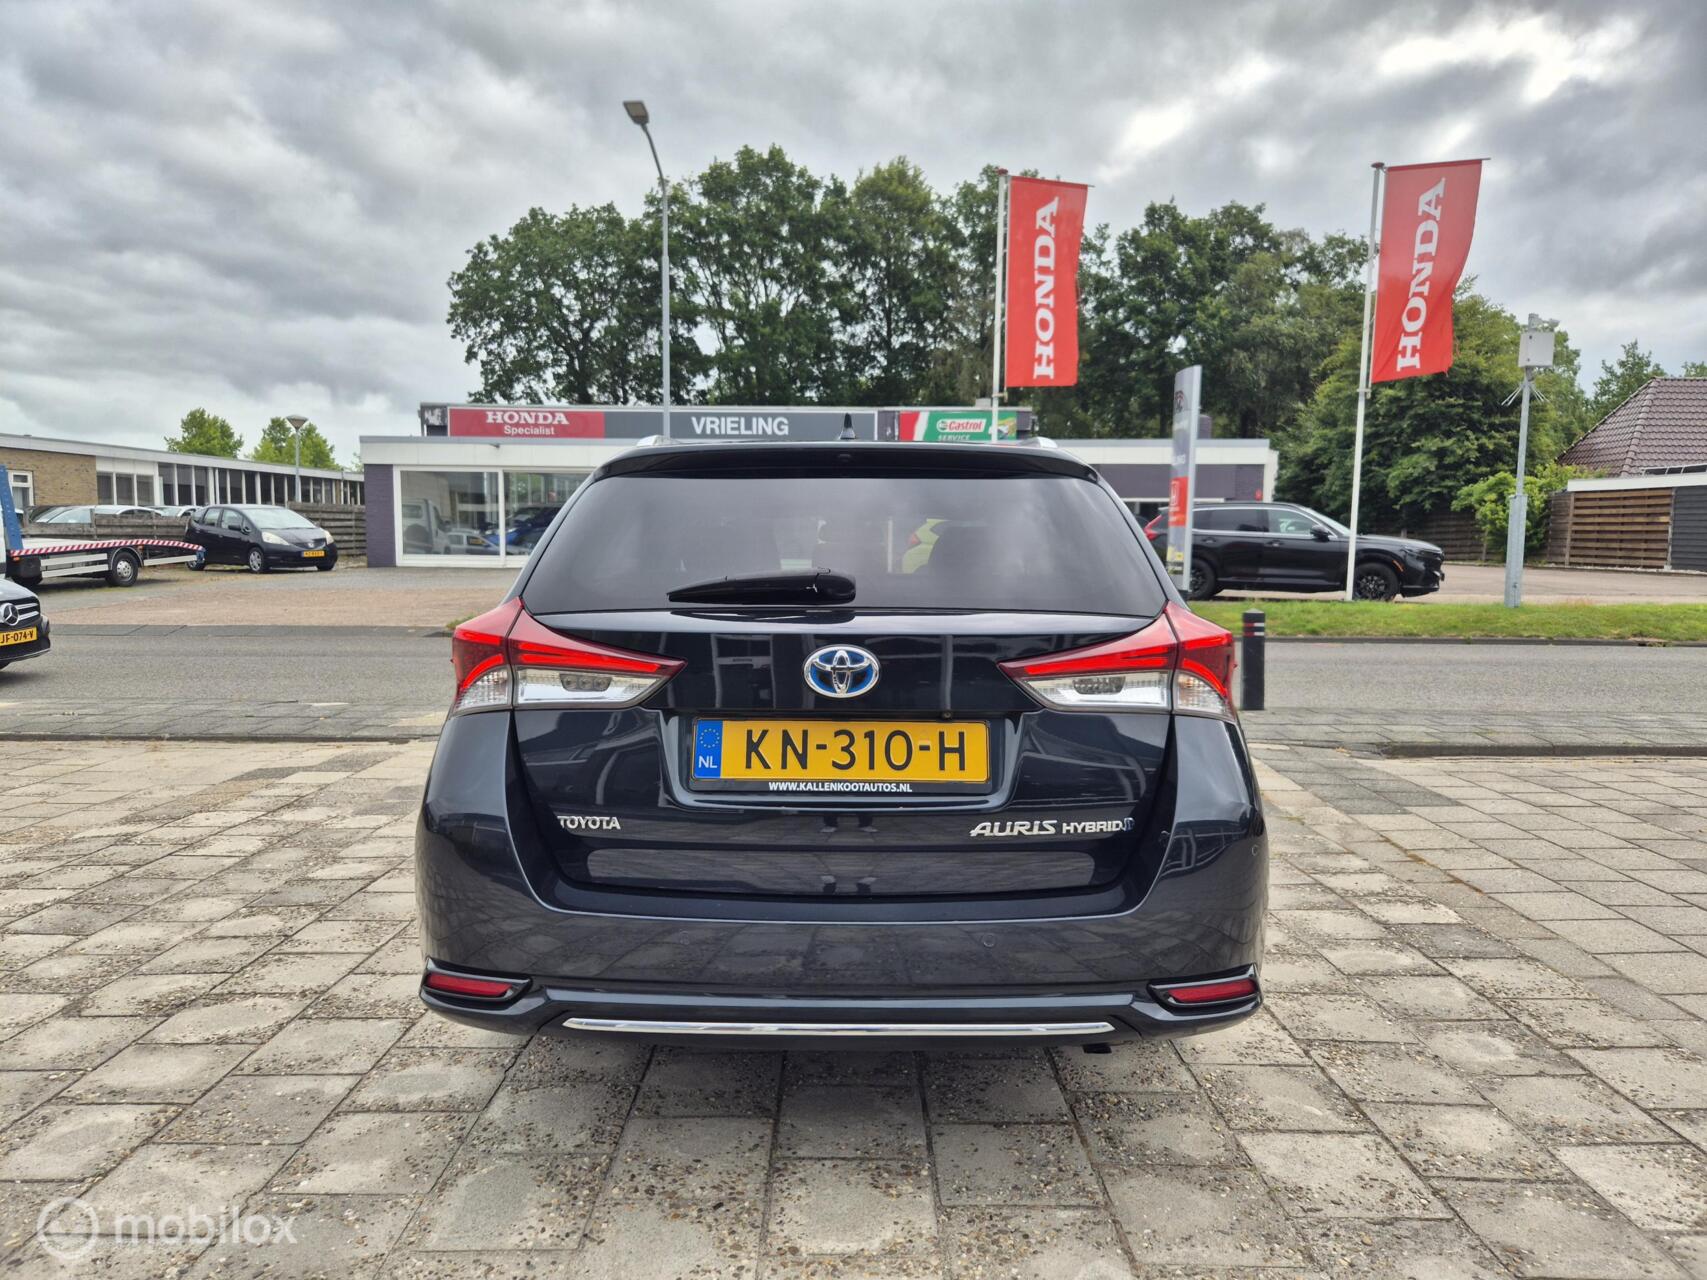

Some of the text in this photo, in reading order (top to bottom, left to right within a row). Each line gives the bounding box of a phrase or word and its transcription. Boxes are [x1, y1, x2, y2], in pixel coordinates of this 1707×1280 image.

[1396, 177, 1446, 371] HONDA
[1033, 196, 1060, 380] HONDA
[485, 411, 570, 425] HONDA
[503, 425, 555, 436] Specialist
[691, 416, 789, 436] VRIELING
[948, 421, 982, 431] Castrol
[0, 630, 34, 644] JF-074-V
[744, 728, 966, 772] KN-310-H
[698, 755, 718, 769] NL
[768, 781, 913, 793] WWW.KALLENKOOTAUTOS.NL
[556, 815, 622, 830] TOYOTA
[969, 820, 1124, 837] AURIS HYBRID
